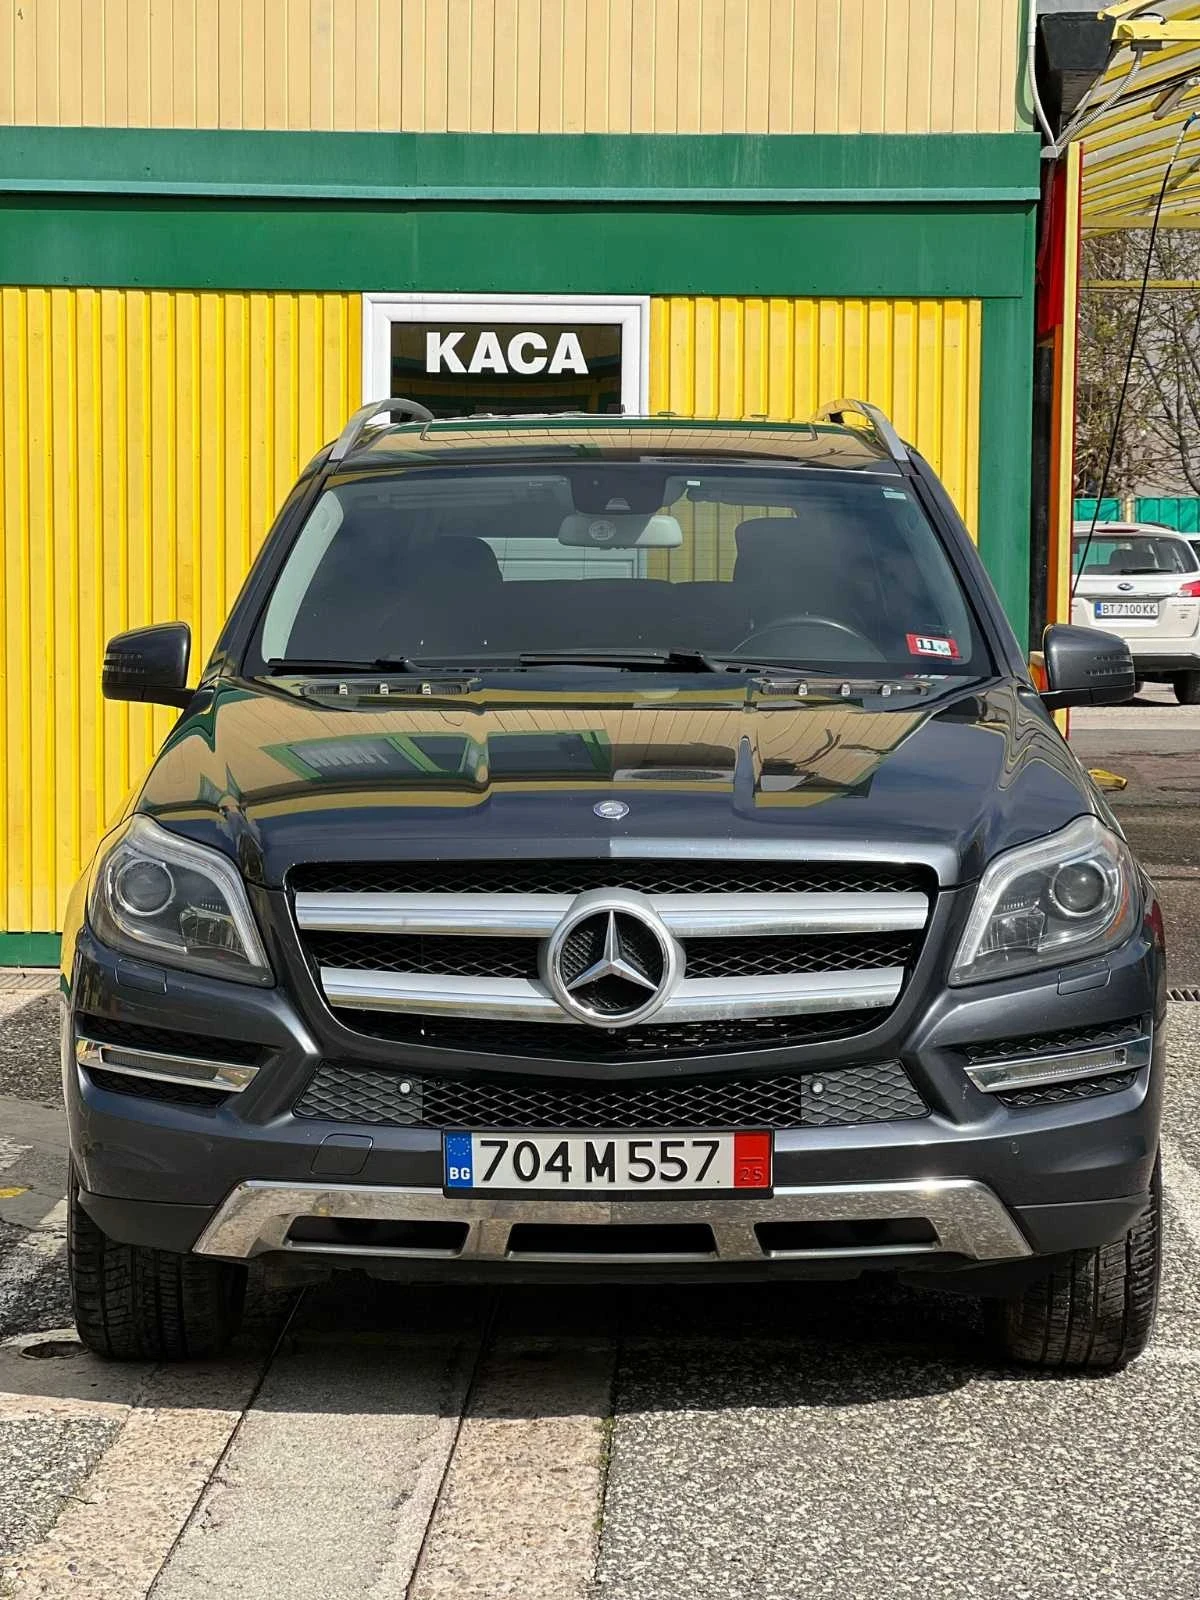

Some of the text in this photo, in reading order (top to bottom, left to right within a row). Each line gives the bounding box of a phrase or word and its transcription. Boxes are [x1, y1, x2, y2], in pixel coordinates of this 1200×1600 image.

[426, 332, 589, 374] КАСА
[449, 1167, 471, 1180] BG
[480, 1140, 573, 1182] 704
[585, 1141, 616, 1182] M
[739, 1167, 763, 1181] 25
